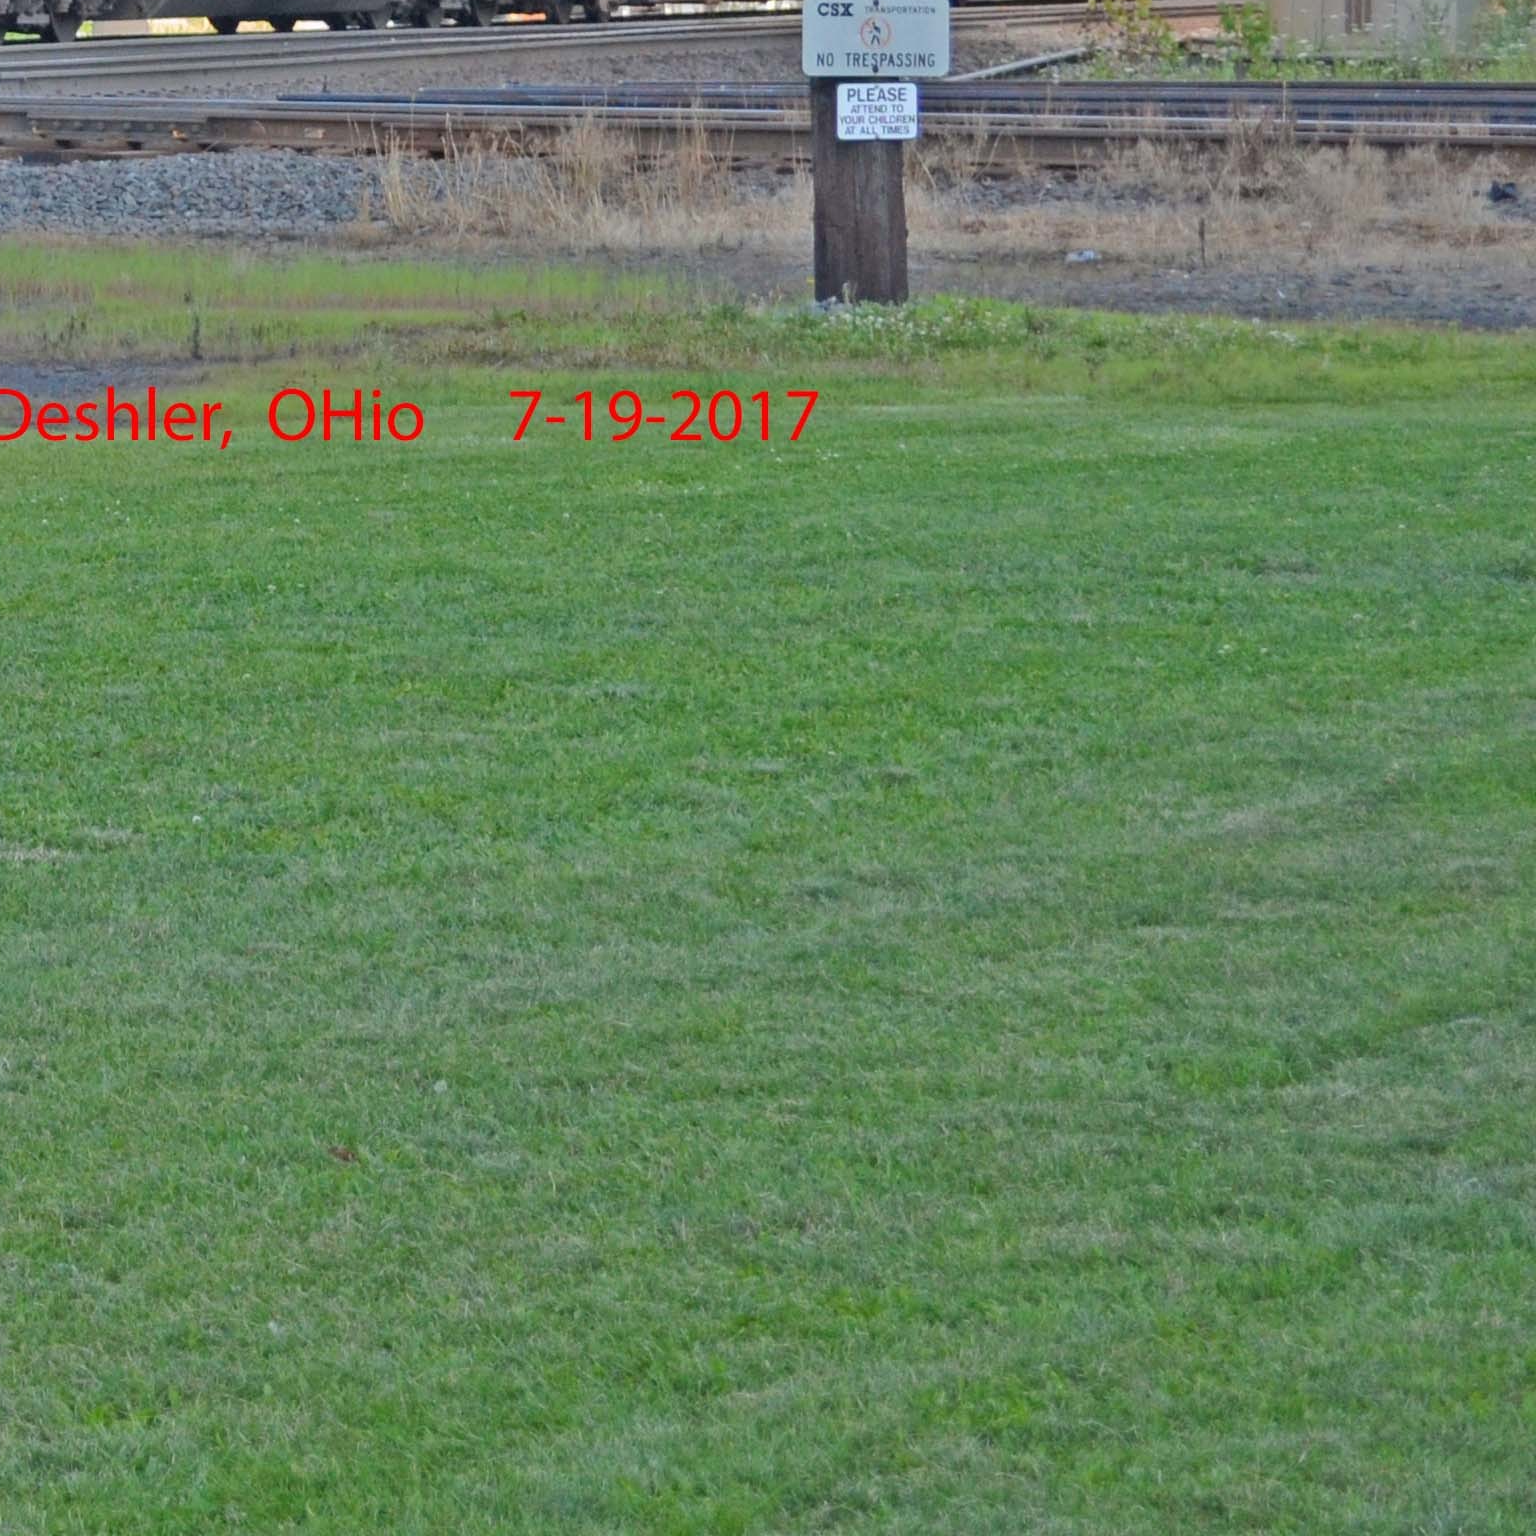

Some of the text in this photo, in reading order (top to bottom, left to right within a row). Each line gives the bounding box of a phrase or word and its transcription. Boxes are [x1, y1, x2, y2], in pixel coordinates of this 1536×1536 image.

[817, 2, 854, 16] CSX
[816, 52, 936, 67] NO TRESPASSING
[847, 87, 907, 102] PLEASE
[850, 104, 904, 114] ATTEND TO
[840, 114, 916, 125] YOUR CHILDREN
[845, 125, 910, 136] AT ALL TIMES
